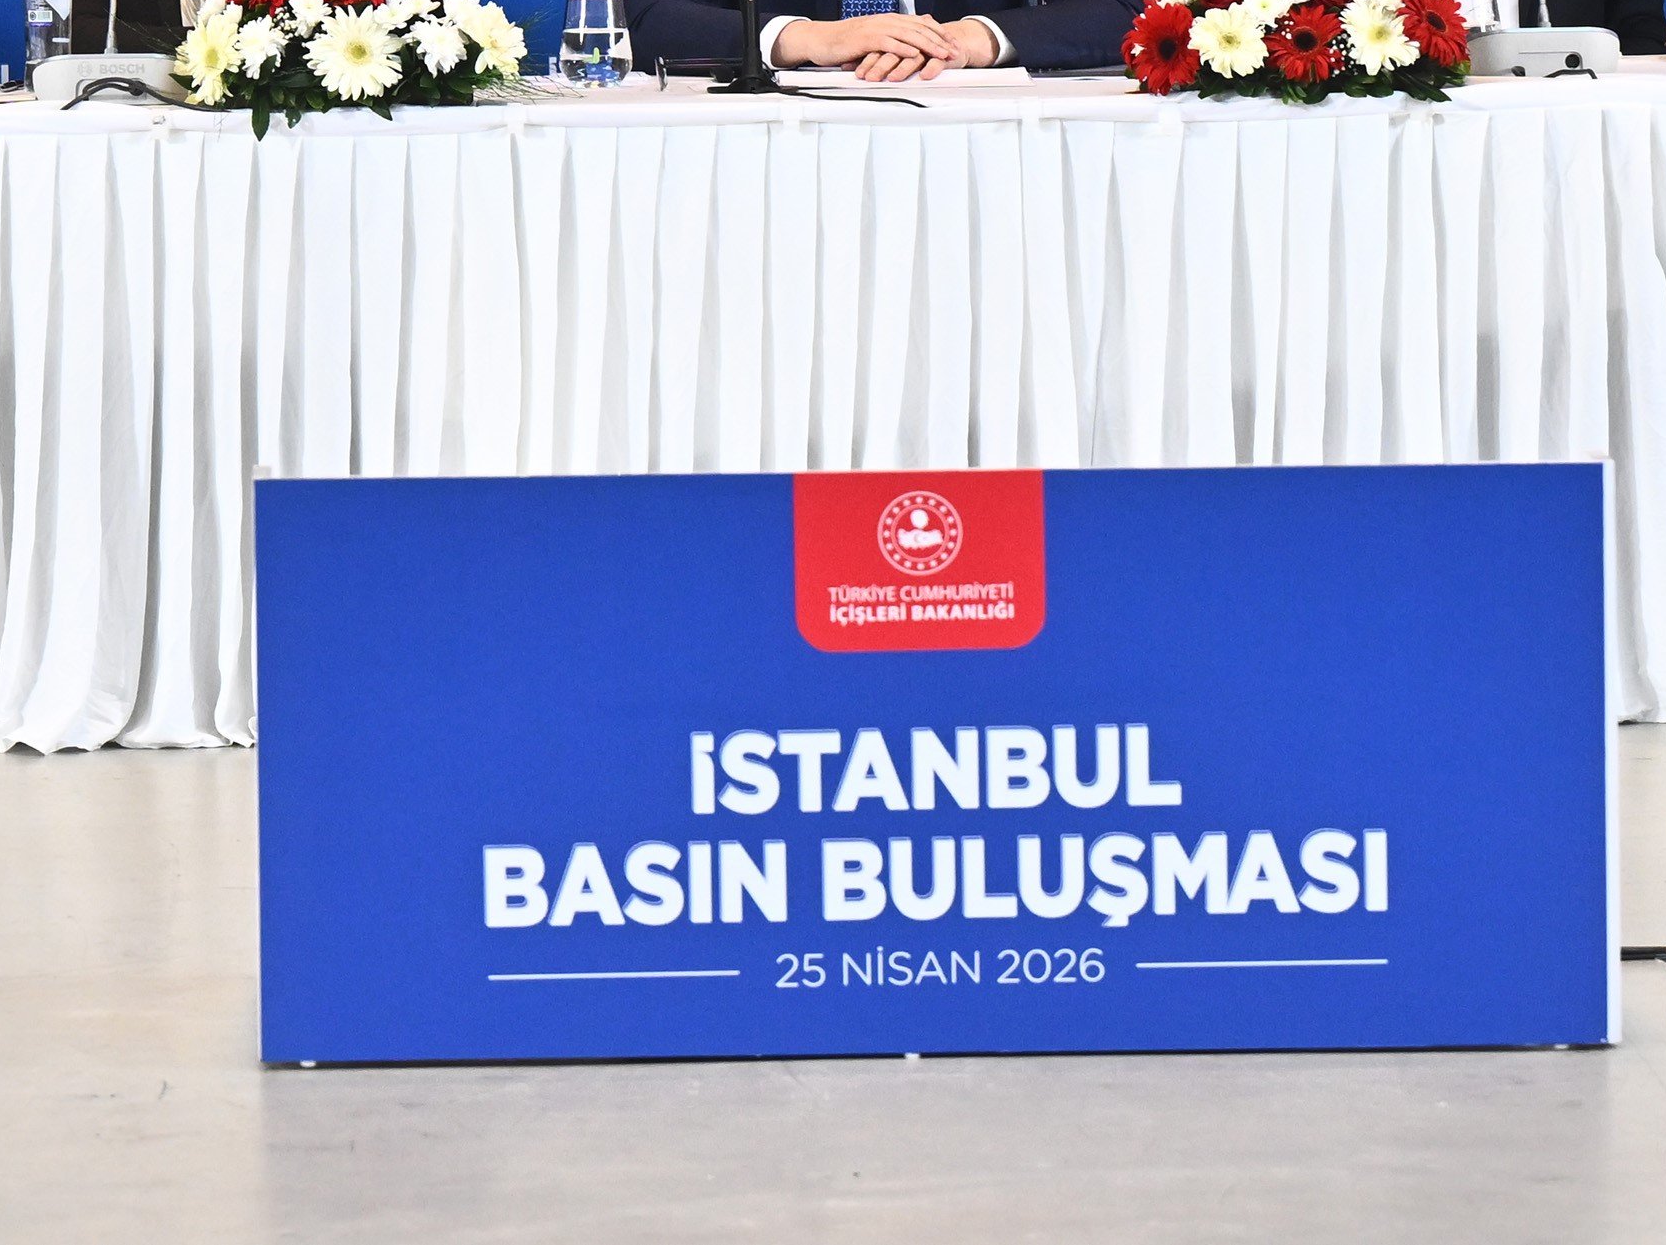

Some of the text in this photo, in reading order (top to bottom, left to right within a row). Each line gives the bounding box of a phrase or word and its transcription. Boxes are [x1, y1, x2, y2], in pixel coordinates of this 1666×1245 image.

[99, 64, 145, 75] BOSCH
[827, 581, 1014, 603] TÜRKİYE CUMHURİYETİ
[829, 600, 1015, 627] İÇİŞLERİ BAKANLIĞI
[691, 724, 1183, 816] İSTANBUL
[483, 829, 1390, 929] BASIN BULUŞMASI
[775, 945, 1107, 988] 25 NİSAN 2026
